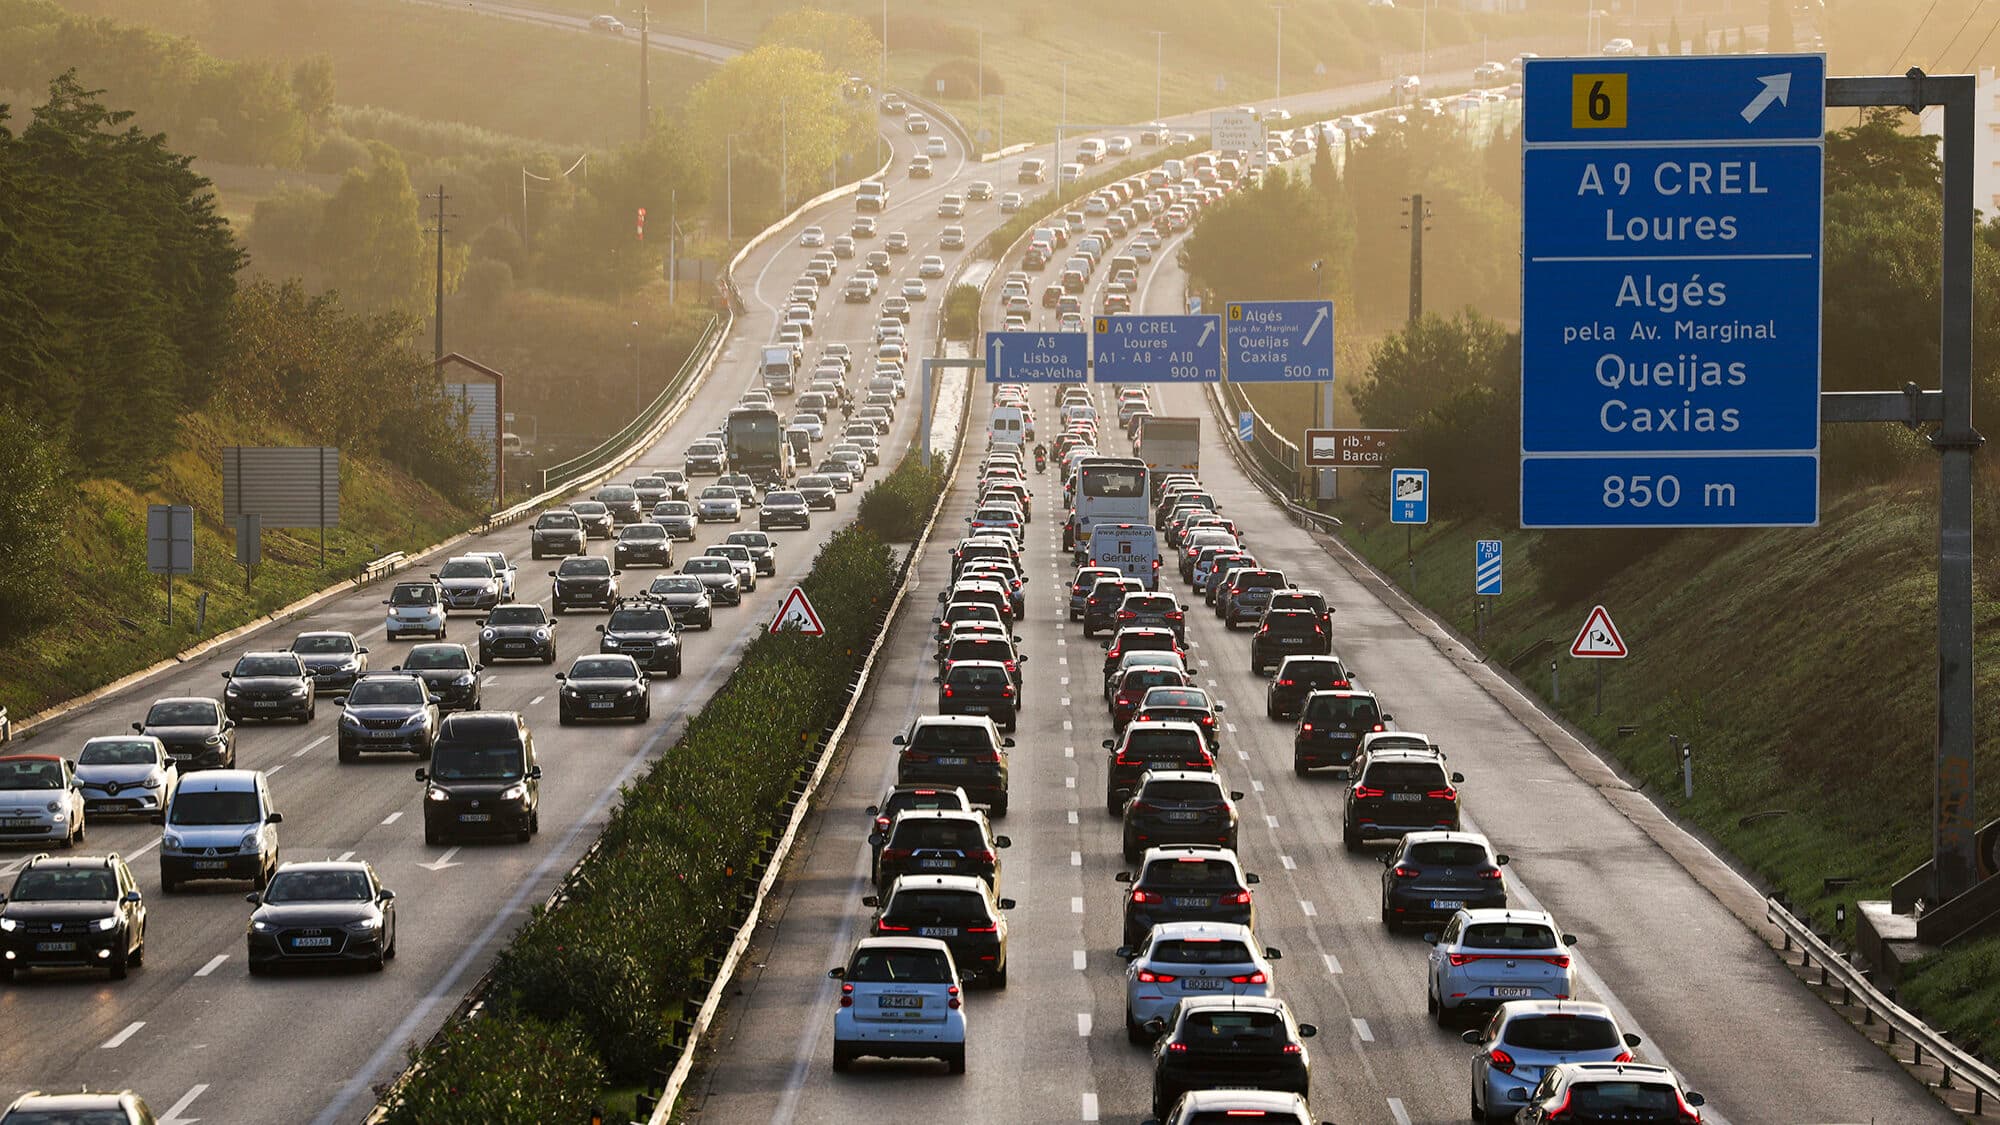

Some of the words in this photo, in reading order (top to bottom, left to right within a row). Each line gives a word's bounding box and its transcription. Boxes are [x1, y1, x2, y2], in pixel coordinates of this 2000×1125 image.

[1588, 80, 1611, 122] 6
[1654, 161, 1769, 196] CREL
[1606, 208, 1738, 242] Loures
[1615, 273, 1727, 313] Algés
[1231, 307, 1239, 319] 6
[1245, 309, 1283, 324] Algés
[1139, 321, 1177, 334] CREL
[1264, 323, 1299, 333] Marginal
[1564, 321, 1616, 345] pela
[1630, 321, 1661, 340] Av.
[1674, 319, 1777, 344] Marginal
[1123, 336, 1168, 349] Loures
[1238, 335, 1289, 350] Queijas
[1023, 351, 1068, 365] Lisboa
[1240, 350, 1288, 363] Caxias
[1170, 366, 1199, 378] 900
[1204, 368, 1217, 378] m
[1284, 365, 1312, 378] 500
[1317, 367, 1329, 377] m
[1595, 353, 1746, 392] Queijas
[1600, 399, 1740, 433] Caxias
[1602, 474, 1681, 508] 850
[1704, 483, 1736, 507] m
[1480, 542, 1499, 553] 750
[1102, 553, 1147, 562] Genutek
